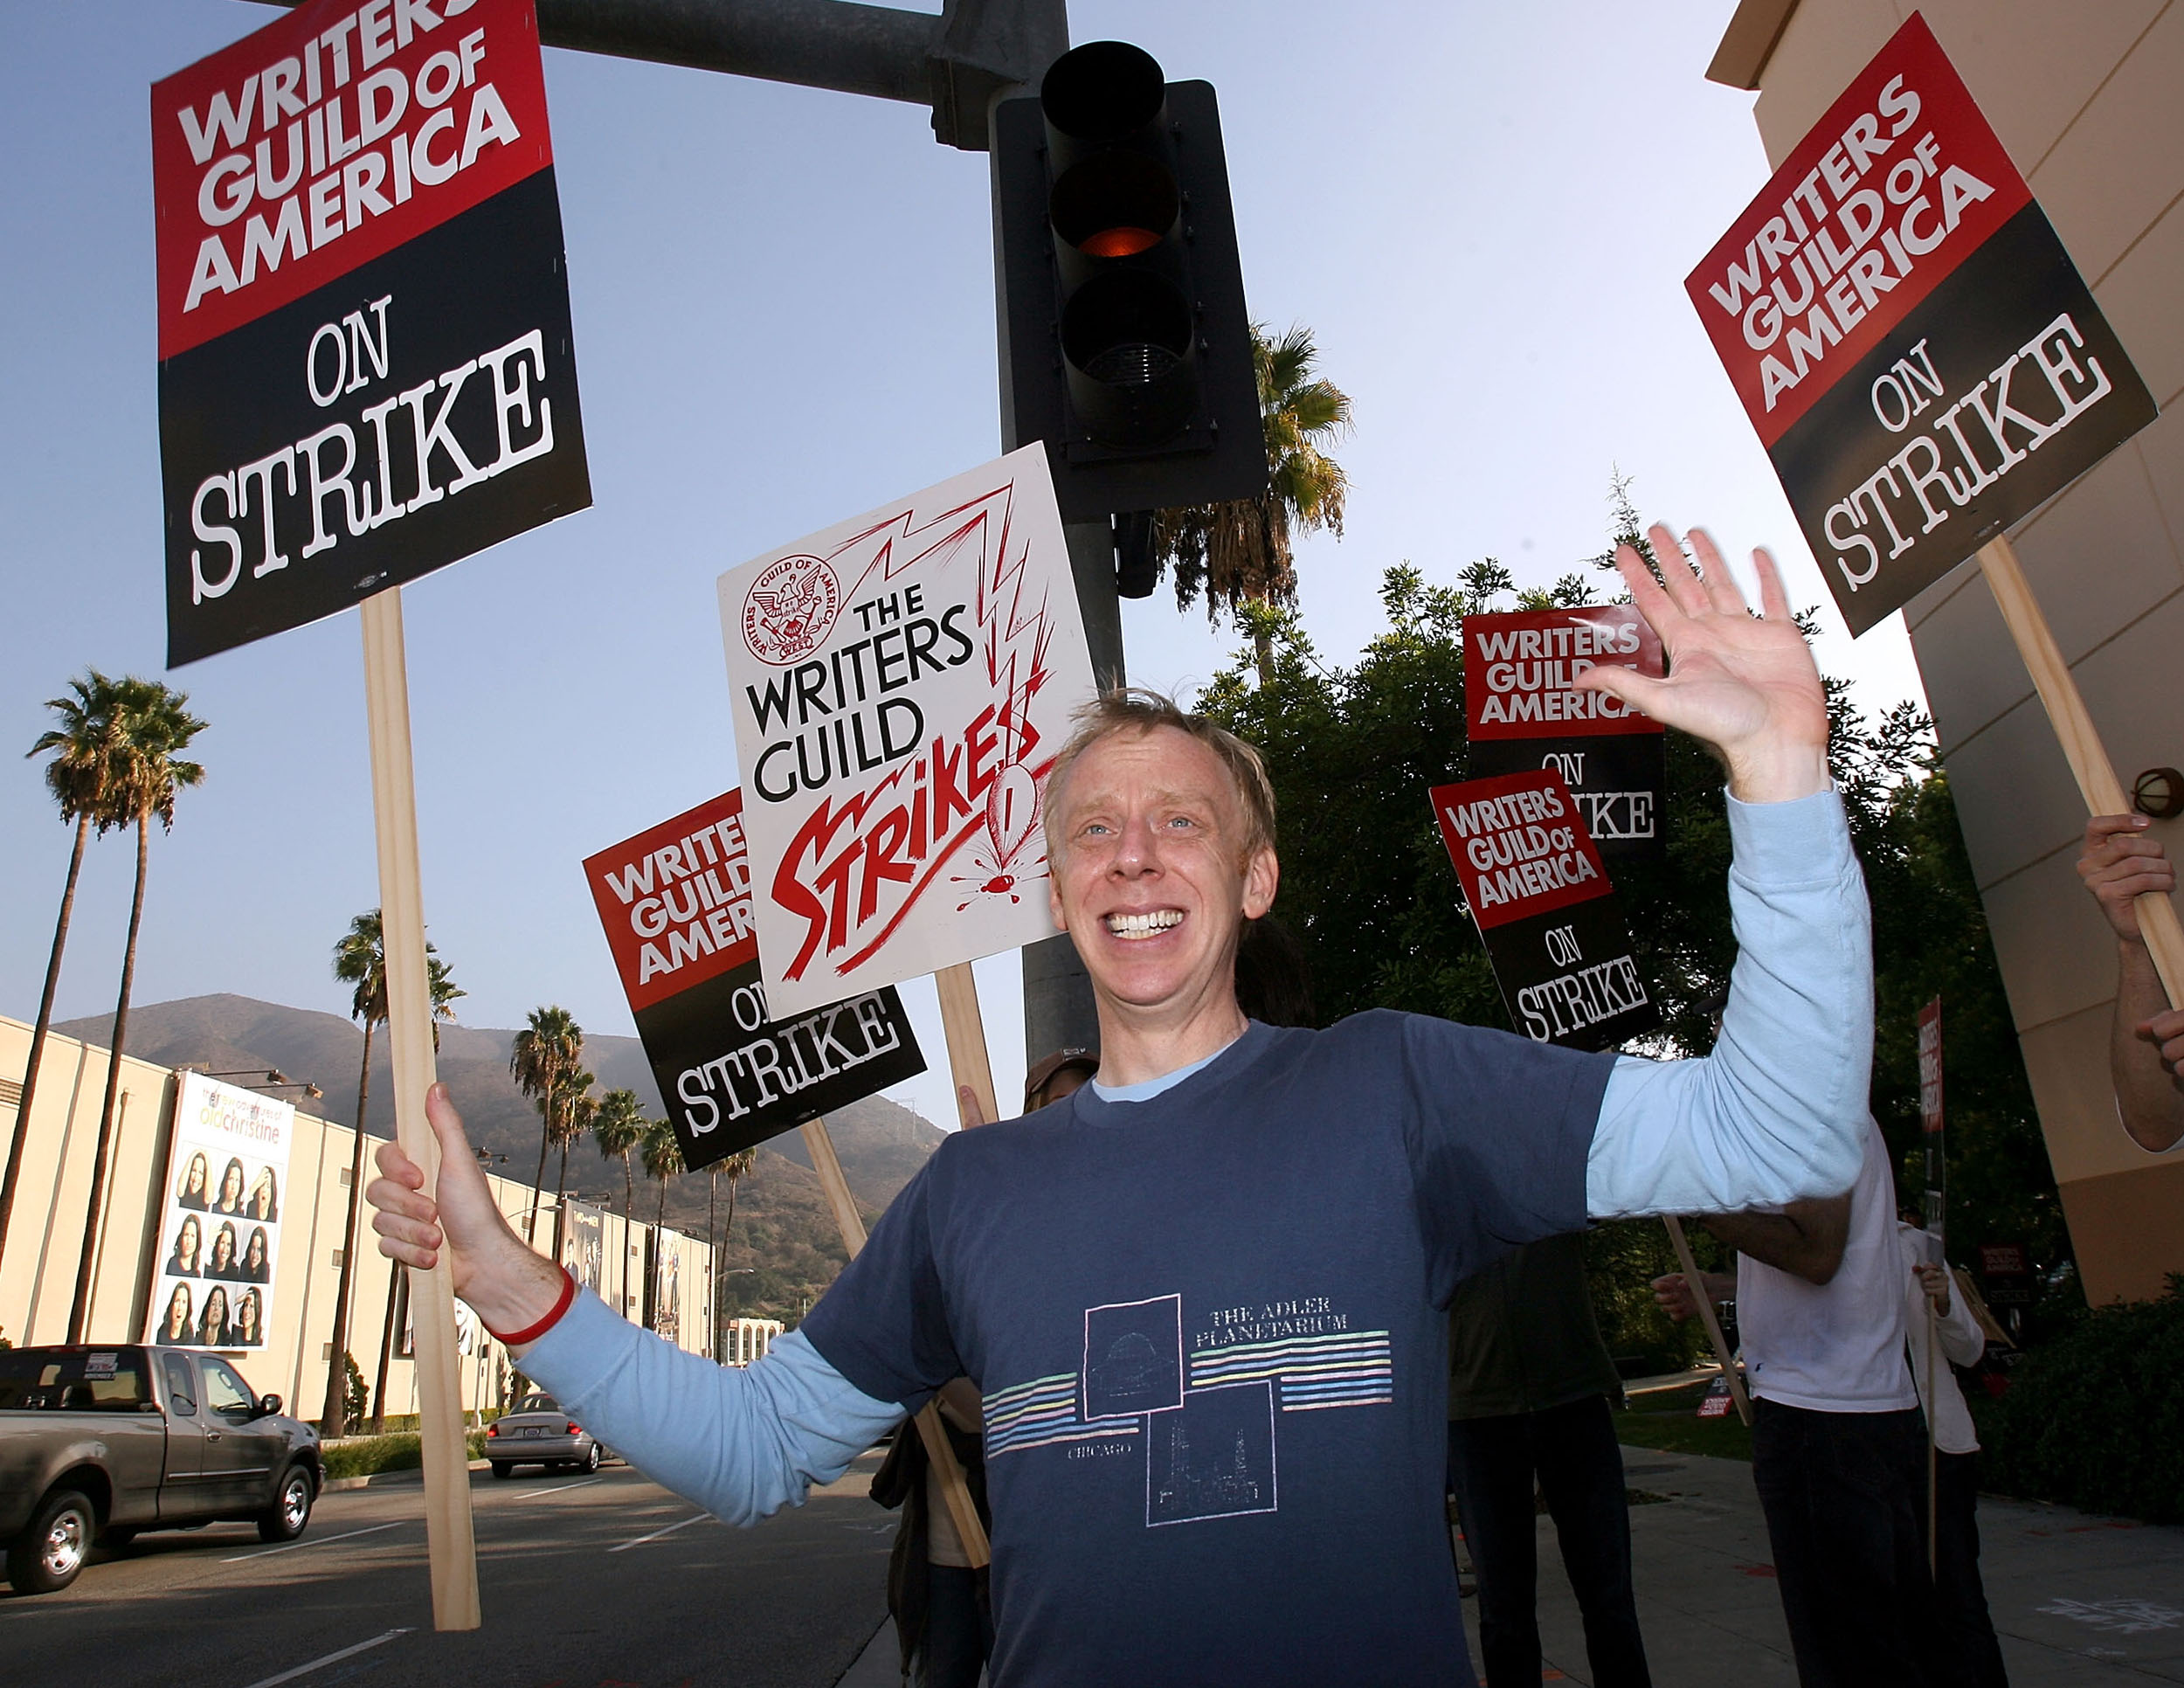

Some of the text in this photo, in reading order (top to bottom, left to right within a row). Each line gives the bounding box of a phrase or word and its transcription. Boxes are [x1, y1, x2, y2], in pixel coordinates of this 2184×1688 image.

[177, 0, 478, 166] WRITER
[197, 26, 486, 228] GUILD OF
[183, 81, 521, 313] AMERICA
[1708, 73, 1922, 317] WRITERS
[1741, 131, 1941, 351] GUILD OF
[1759, 163, 1995, 412] AMERICA
[307, 294, 392, 407] ON
[1870, 338, 1945, 432] ON
[190, 329, 555, 605] STRIKE
[1823, 313, 2111, 592] STRIKE
[746, 559, 837, 655] WRITERS GUILD OF AMERICA
[853, 584, 925, 632] THE
[1476, 623, 1641, 661] WRITERS
[745, 605, 973, 737] WRITERS
[754, 696, 924, 803] GUILD
[604, 811, 747, 904] WRITE
[1445, 787, 1565, 838] WRITERS
[1467, 826, 1575, 871] GUILD OF
[1477, 850, 1599, 909] AMERICA
[1545, 924, 1582, 967] ON
[1517, 955, 1648, 1043] STRIKE
[677, 991, 900, 1138] STRIKE
[1196, 1314, 1348, 1347] PLANETARIUM
[1210, 1297, 1330, 1326] THE ADLER
